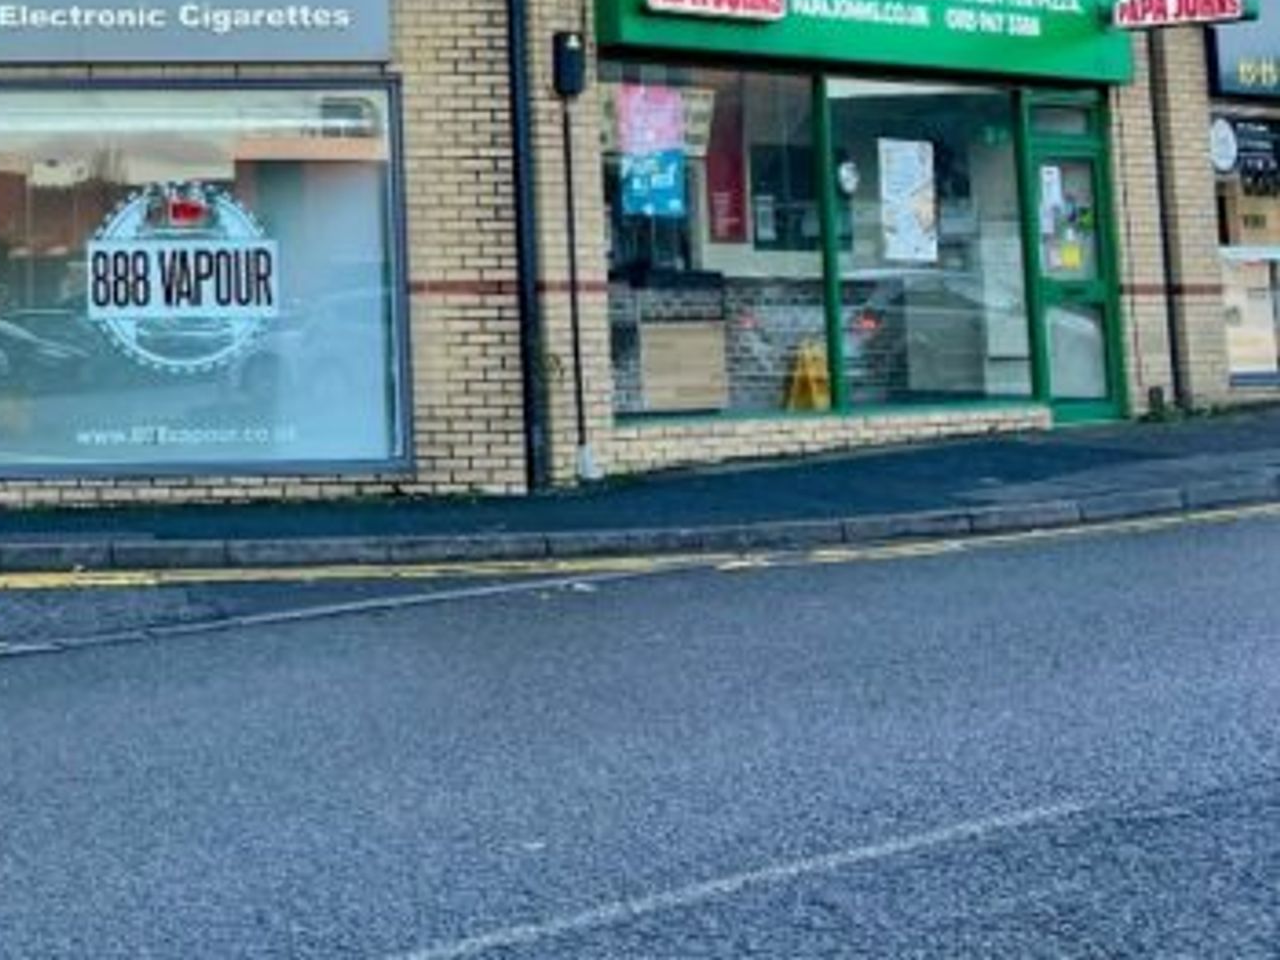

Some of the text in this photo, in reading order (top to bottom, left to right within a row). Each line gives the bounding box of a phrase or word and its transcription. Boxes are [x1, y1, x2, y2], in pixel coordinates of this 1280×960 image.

[178, 4, 351, 32] Cigarettes
[92, 246, 274, 308] 888 VAPOUR
